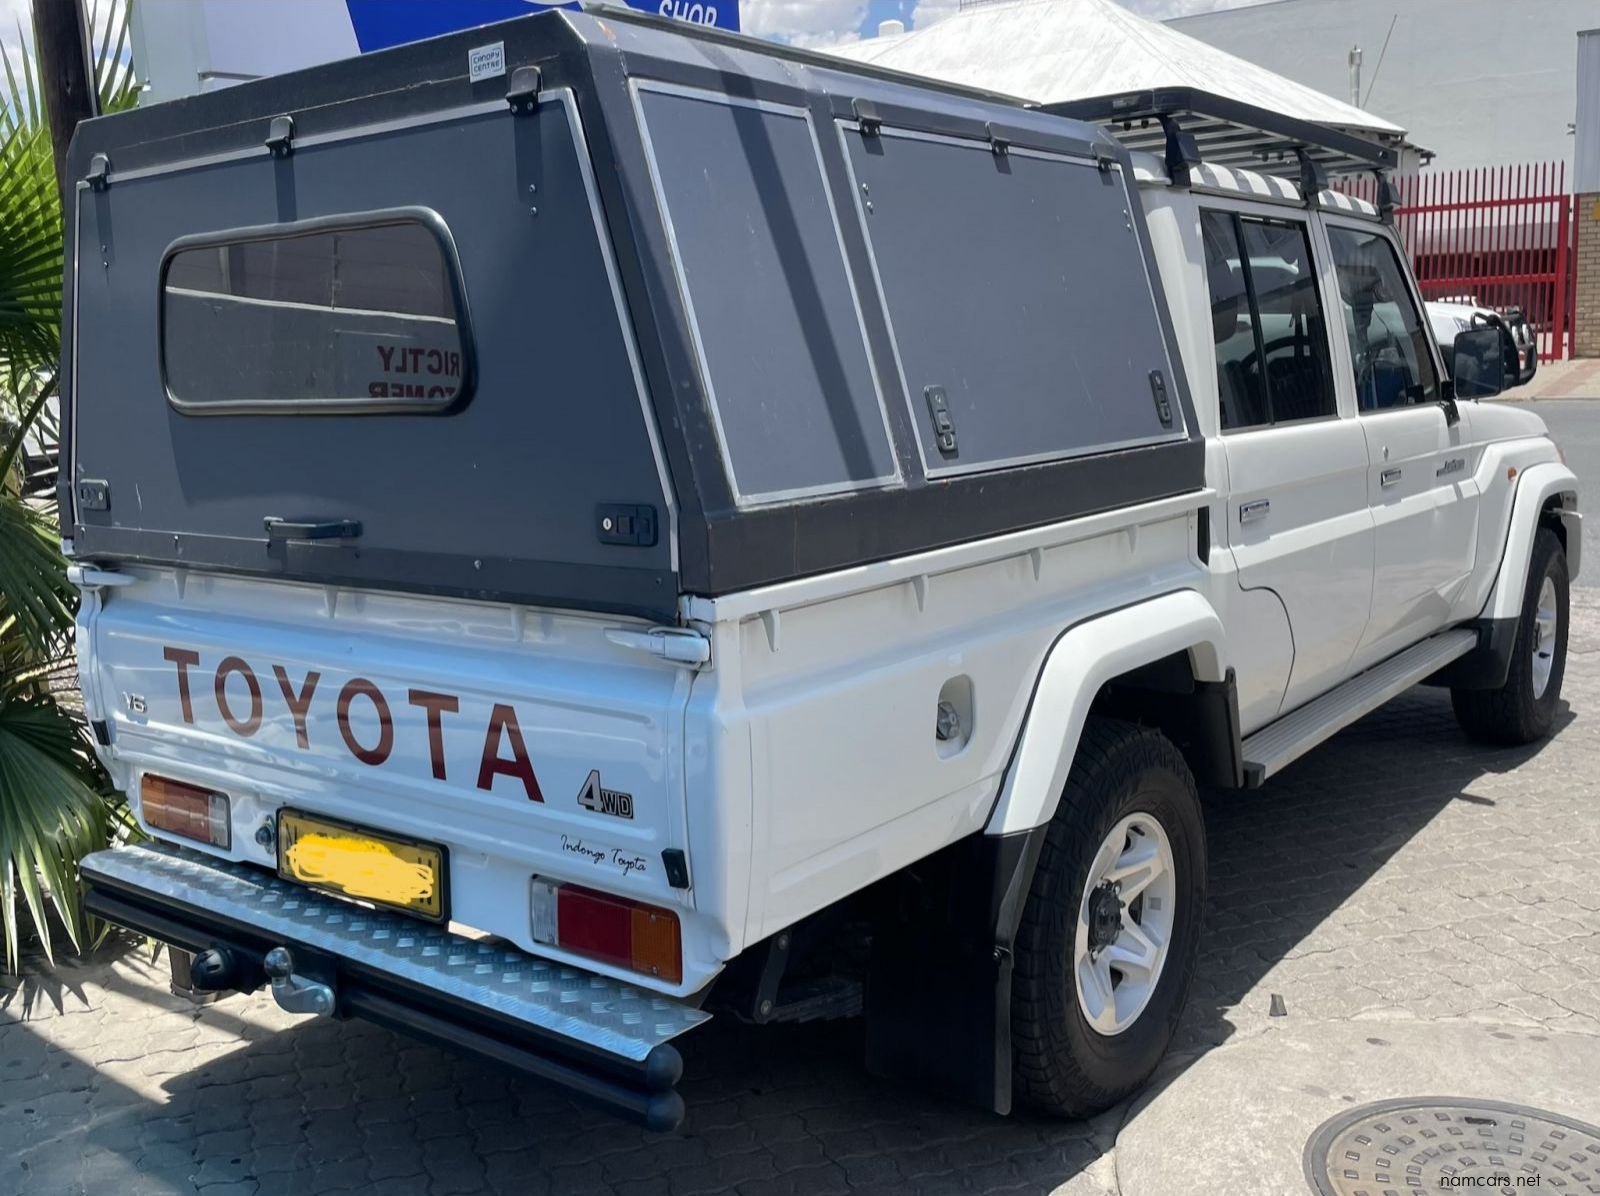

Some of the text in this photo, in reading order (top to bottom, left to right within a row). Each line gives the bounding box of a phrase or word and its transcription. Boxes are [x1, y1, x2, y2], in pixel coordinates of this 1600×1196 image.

[659, 0, 717, 27] SHOP
[473, 51, 500, 64] CANOPY
[474, 60, 500, 72] CENTRE
[163, 646, 545, 803] TOYOTA
[577, 769, 633, 819] 4WD
[561, 834, 646, 876] Indongo Toyota
